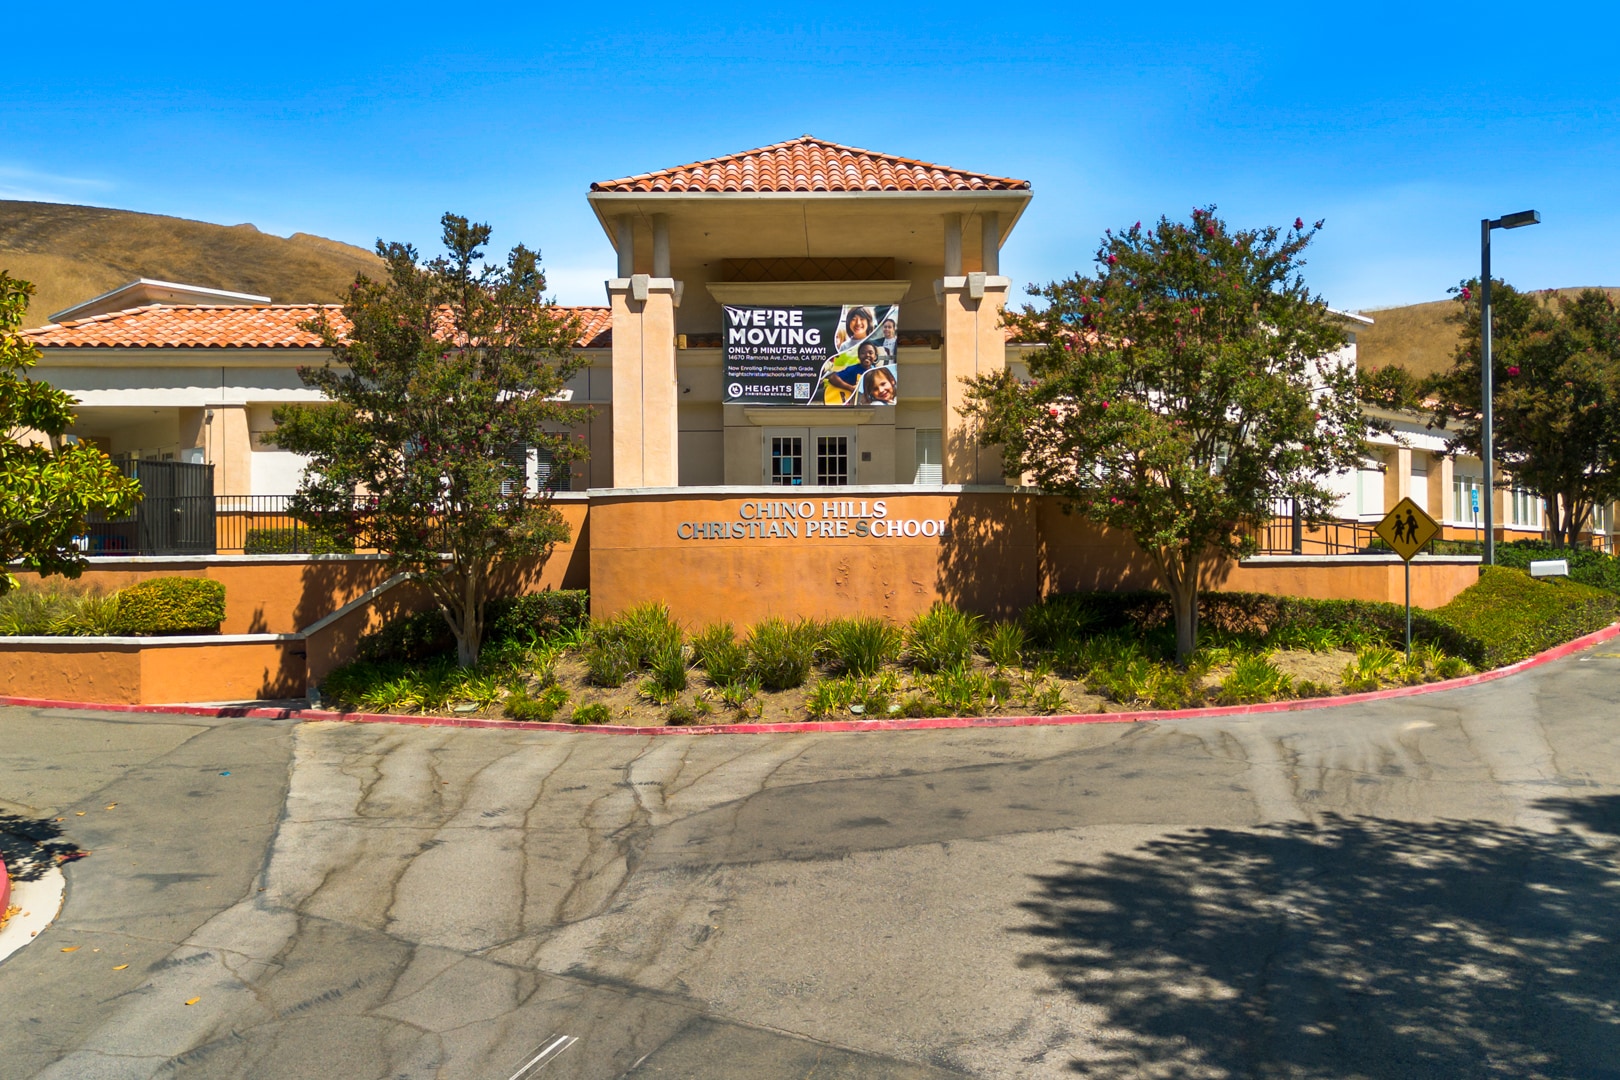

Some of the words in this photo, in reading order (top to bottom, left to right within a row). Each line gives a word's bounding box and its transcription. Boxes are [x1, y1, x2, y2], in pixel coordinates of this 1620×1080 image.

[728, 310, 803, 327] WE'RE
[728, 328, 821, 345] MOVING
[739, 502, 815, 519] CHINO
[822, 501, 888, 519] HILLS
[677, 521, 799, 539] CHRISTIAN
